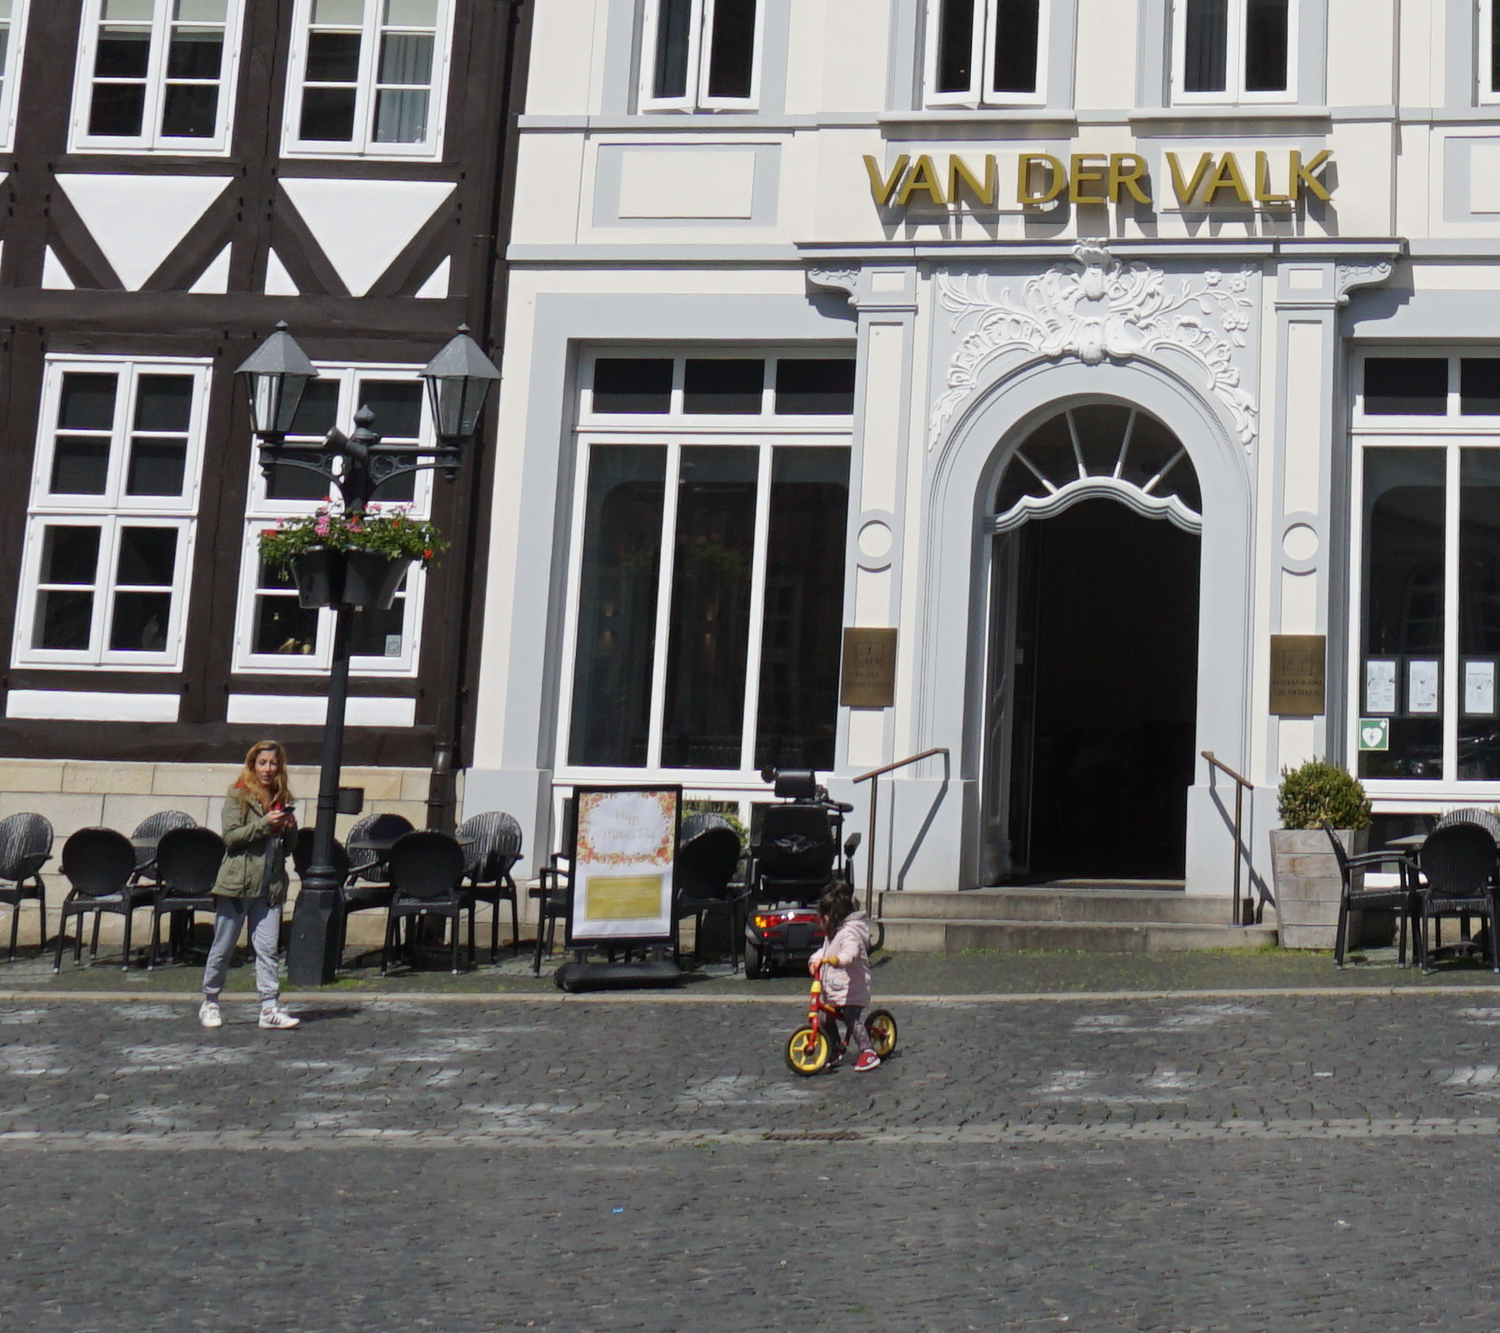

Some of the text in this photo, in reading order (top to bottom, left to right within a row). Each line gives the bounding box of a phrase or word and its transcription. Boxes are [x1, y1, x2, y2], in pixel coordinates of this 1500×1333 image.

[862, 149, 1335, 205] VAN DER VALK
